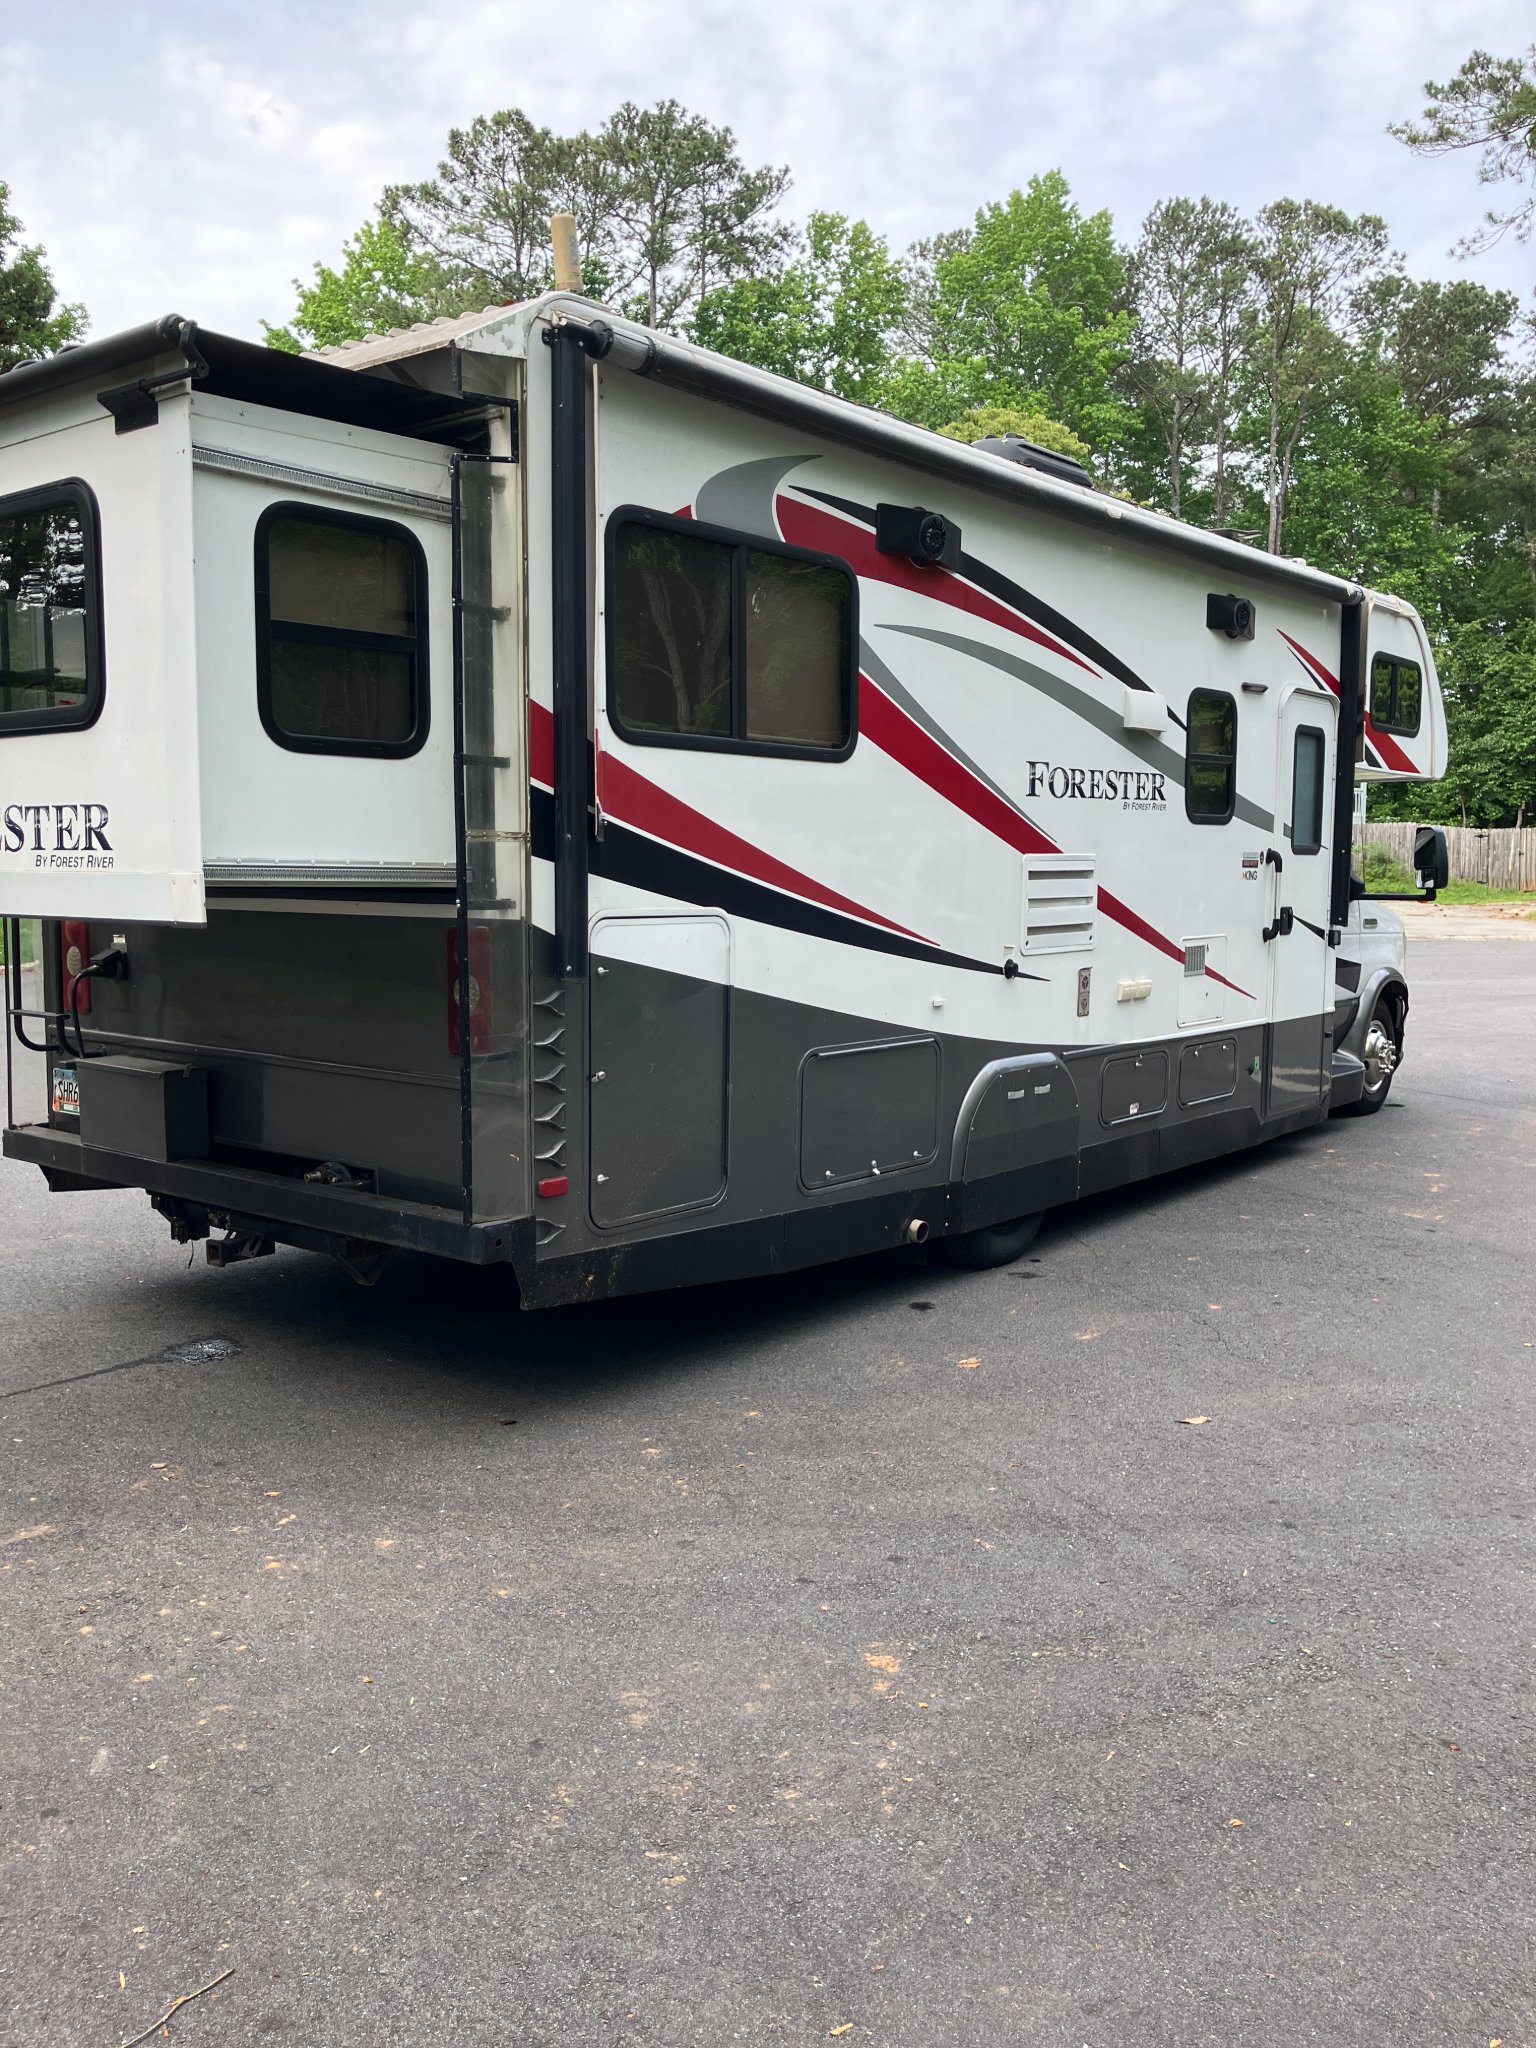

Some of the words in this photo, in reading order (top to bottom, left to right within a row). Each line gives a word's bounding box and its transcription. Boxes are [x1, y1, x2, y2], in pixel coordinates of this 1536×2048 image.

[1025, 760, 1167, 802] FORESTER
[0, 804, 114, 853] STER
[49, 854, 85, 869] FOREST
[86, 854, 114, 869] RIVER
[1244, 870, 1258, 881] KING
